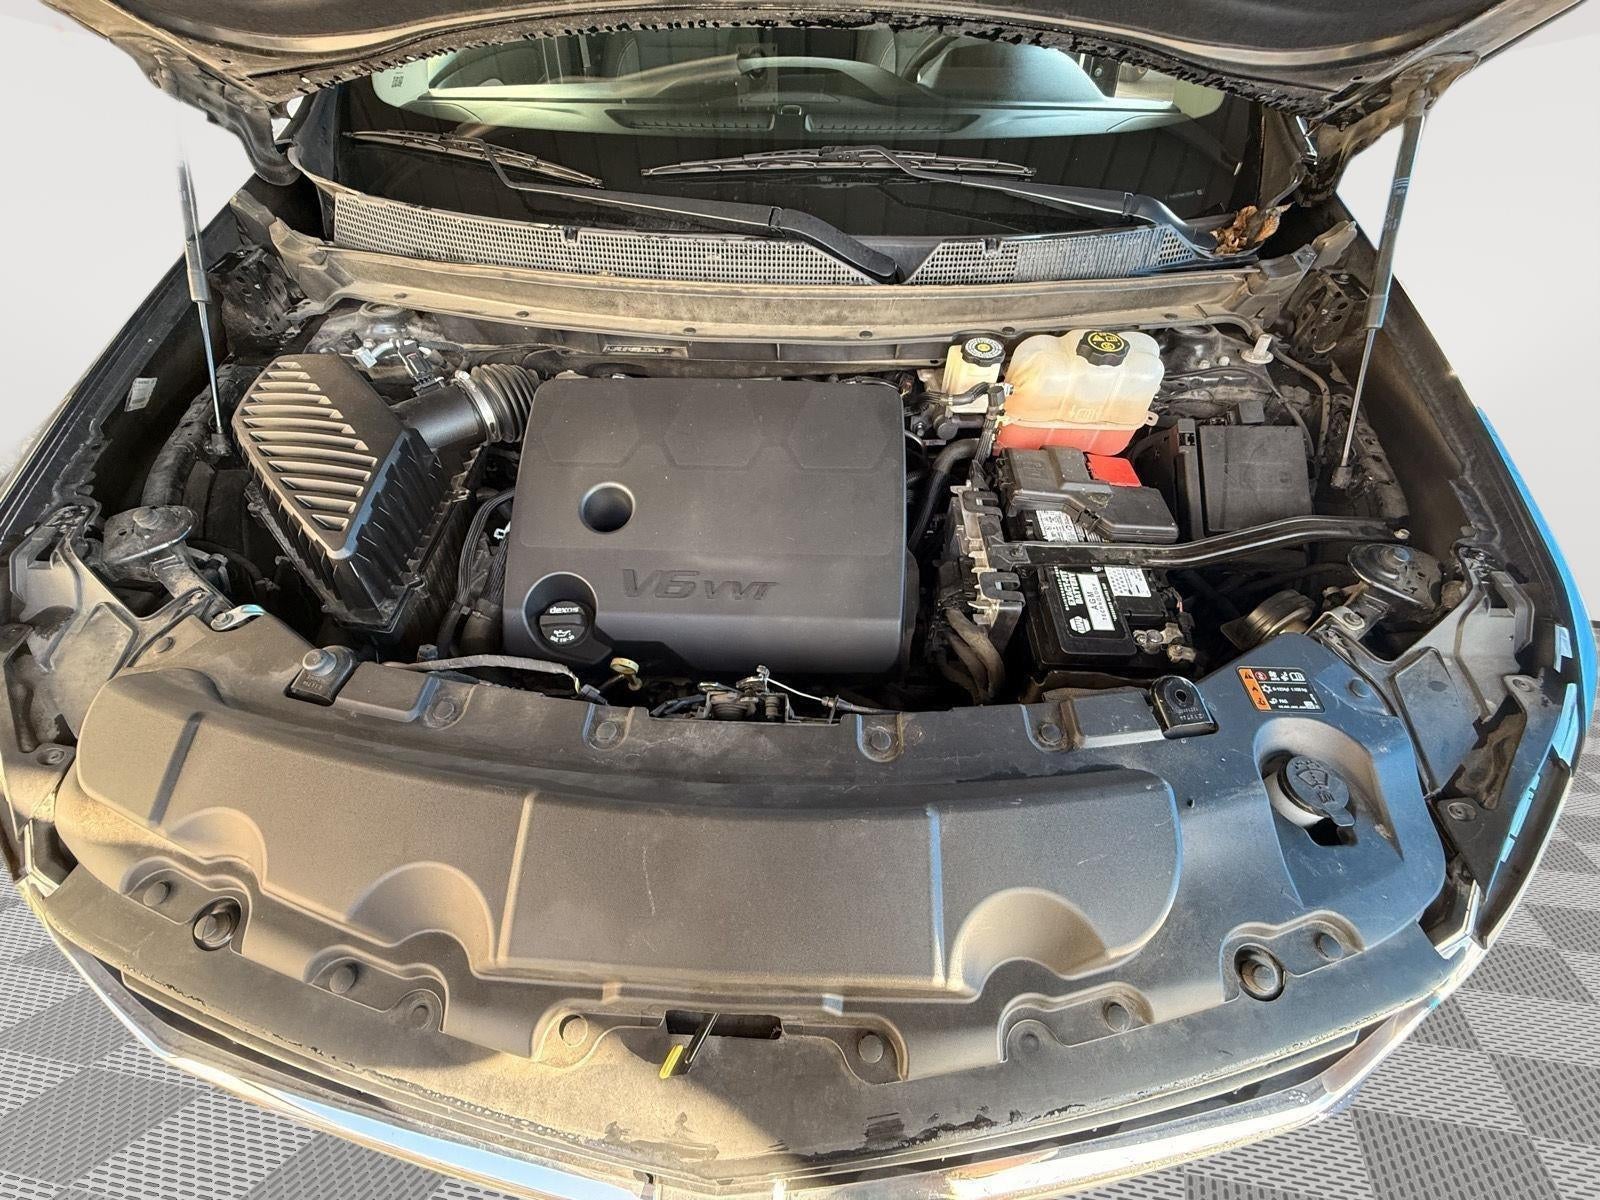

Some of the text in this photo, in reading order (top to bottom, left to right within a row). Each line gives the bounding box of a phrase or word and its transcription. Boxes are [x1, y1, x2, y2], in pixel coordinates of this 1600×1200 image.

[622, 569, 779, 600] V6 VVT
[1068, 572, 1084, 605] BATTERY
[1087, 591, 1099, 611] AGM
[1092, 583, 1107, 621] TECHNOLOGY
